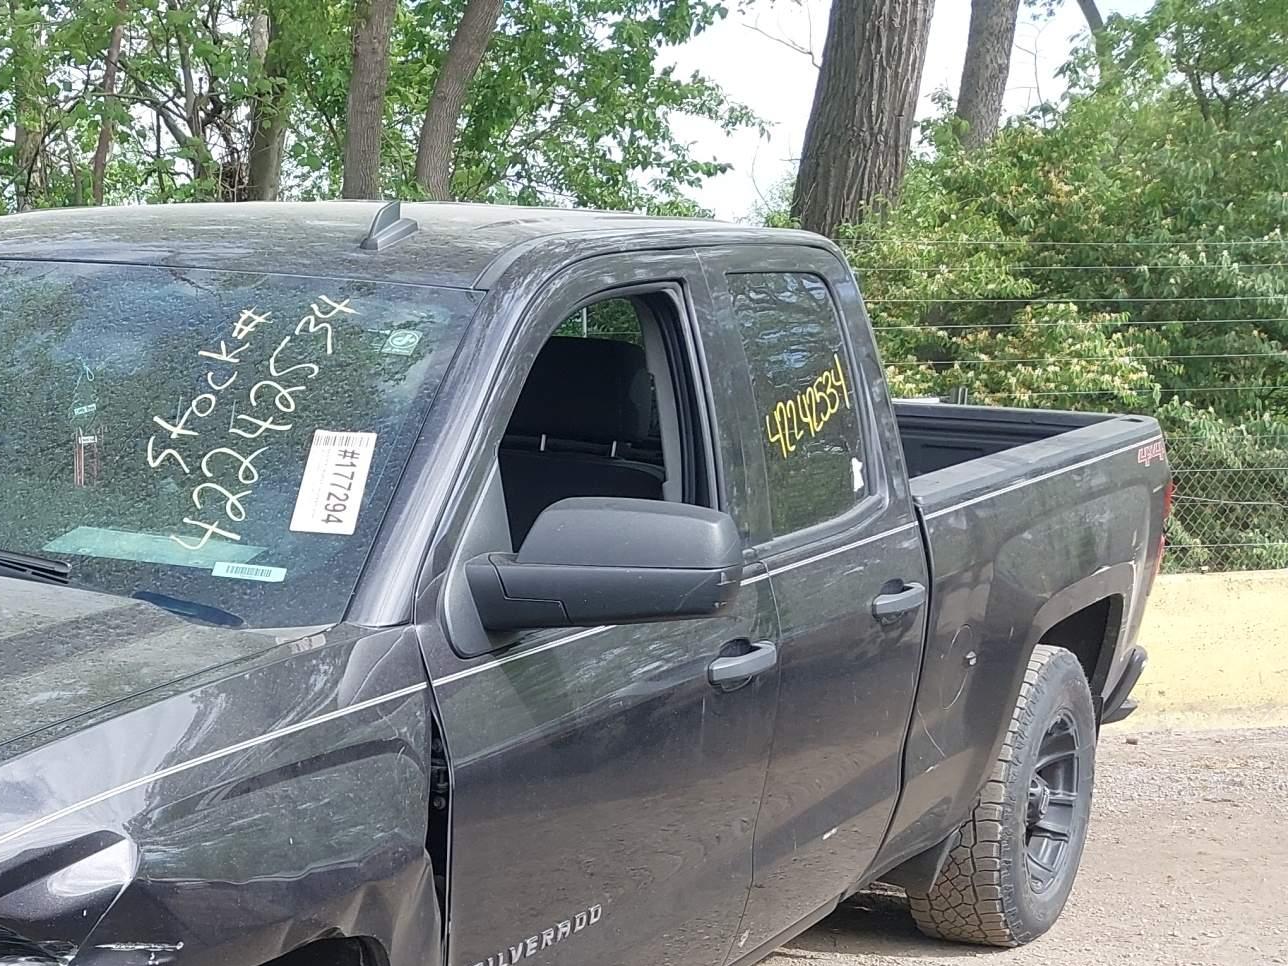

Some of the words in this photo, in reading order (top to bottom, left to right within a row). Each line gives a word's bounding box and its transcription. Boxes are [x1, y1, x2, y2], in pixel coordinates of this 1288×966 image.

[170, 295, 361, 550] 42242534
[765, 353, 850, 459] 42242534
[321, 449, 361, 524] #177294
